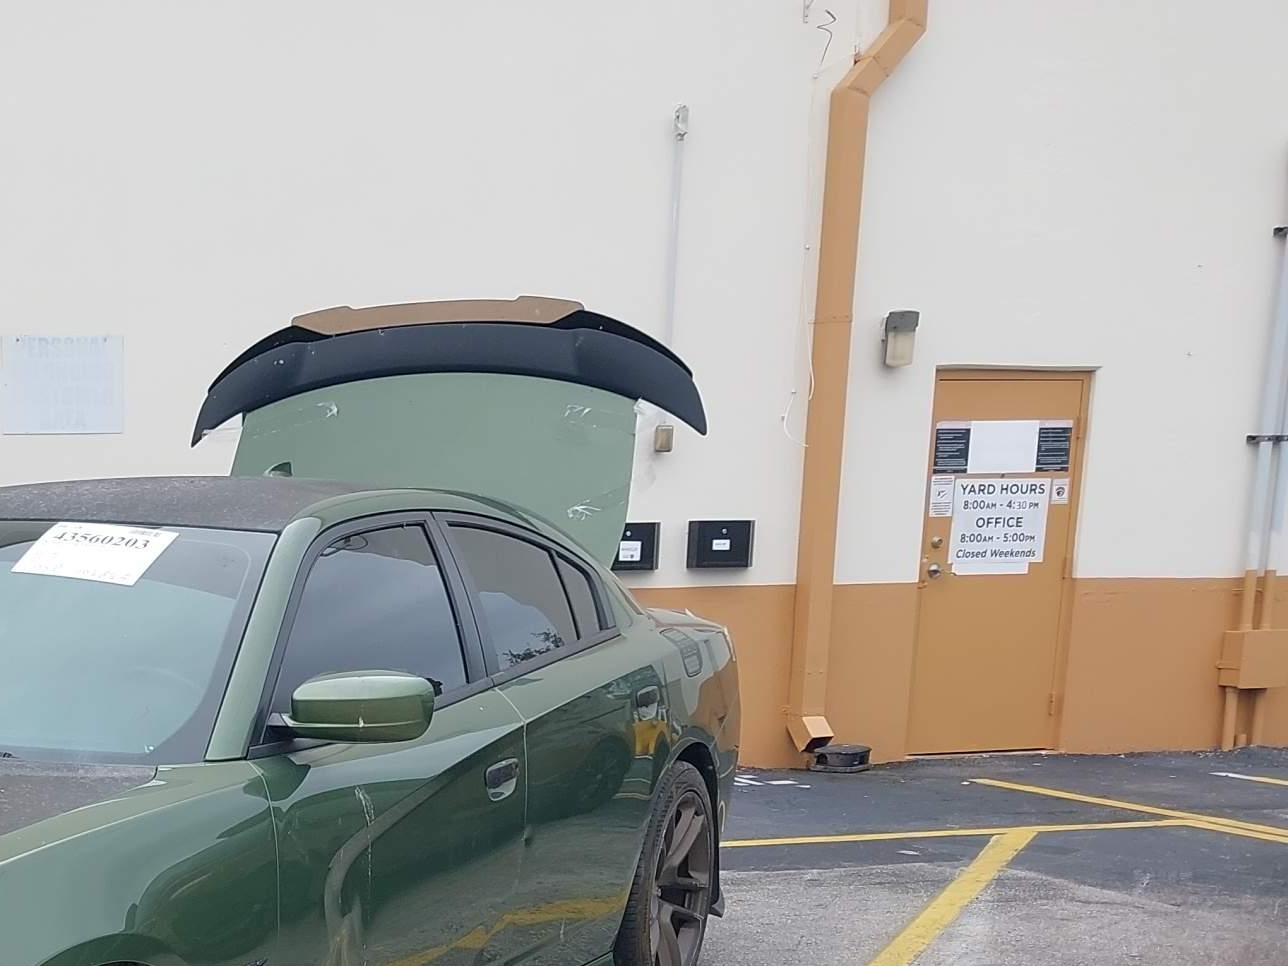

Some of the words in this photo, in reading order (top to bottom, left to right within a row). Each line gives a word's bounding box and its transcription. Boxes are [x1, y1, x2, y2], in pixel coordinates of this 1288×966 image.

[961, 484, 996, 495] YARD
[1000, 483, 1046, 495] HOURS
[963, 500, 997, 510] 8:00AM
[976, 516, 1024, 528] OFFICE
[53, 531, 150, 550] 43560203
[960, 533, 994, 543] 8:00AM
[1003, 532, 1036, 543] 5:00PM
[956, 549, 988, 559] Closed
[990, 548, 1037, 559] Weekends
